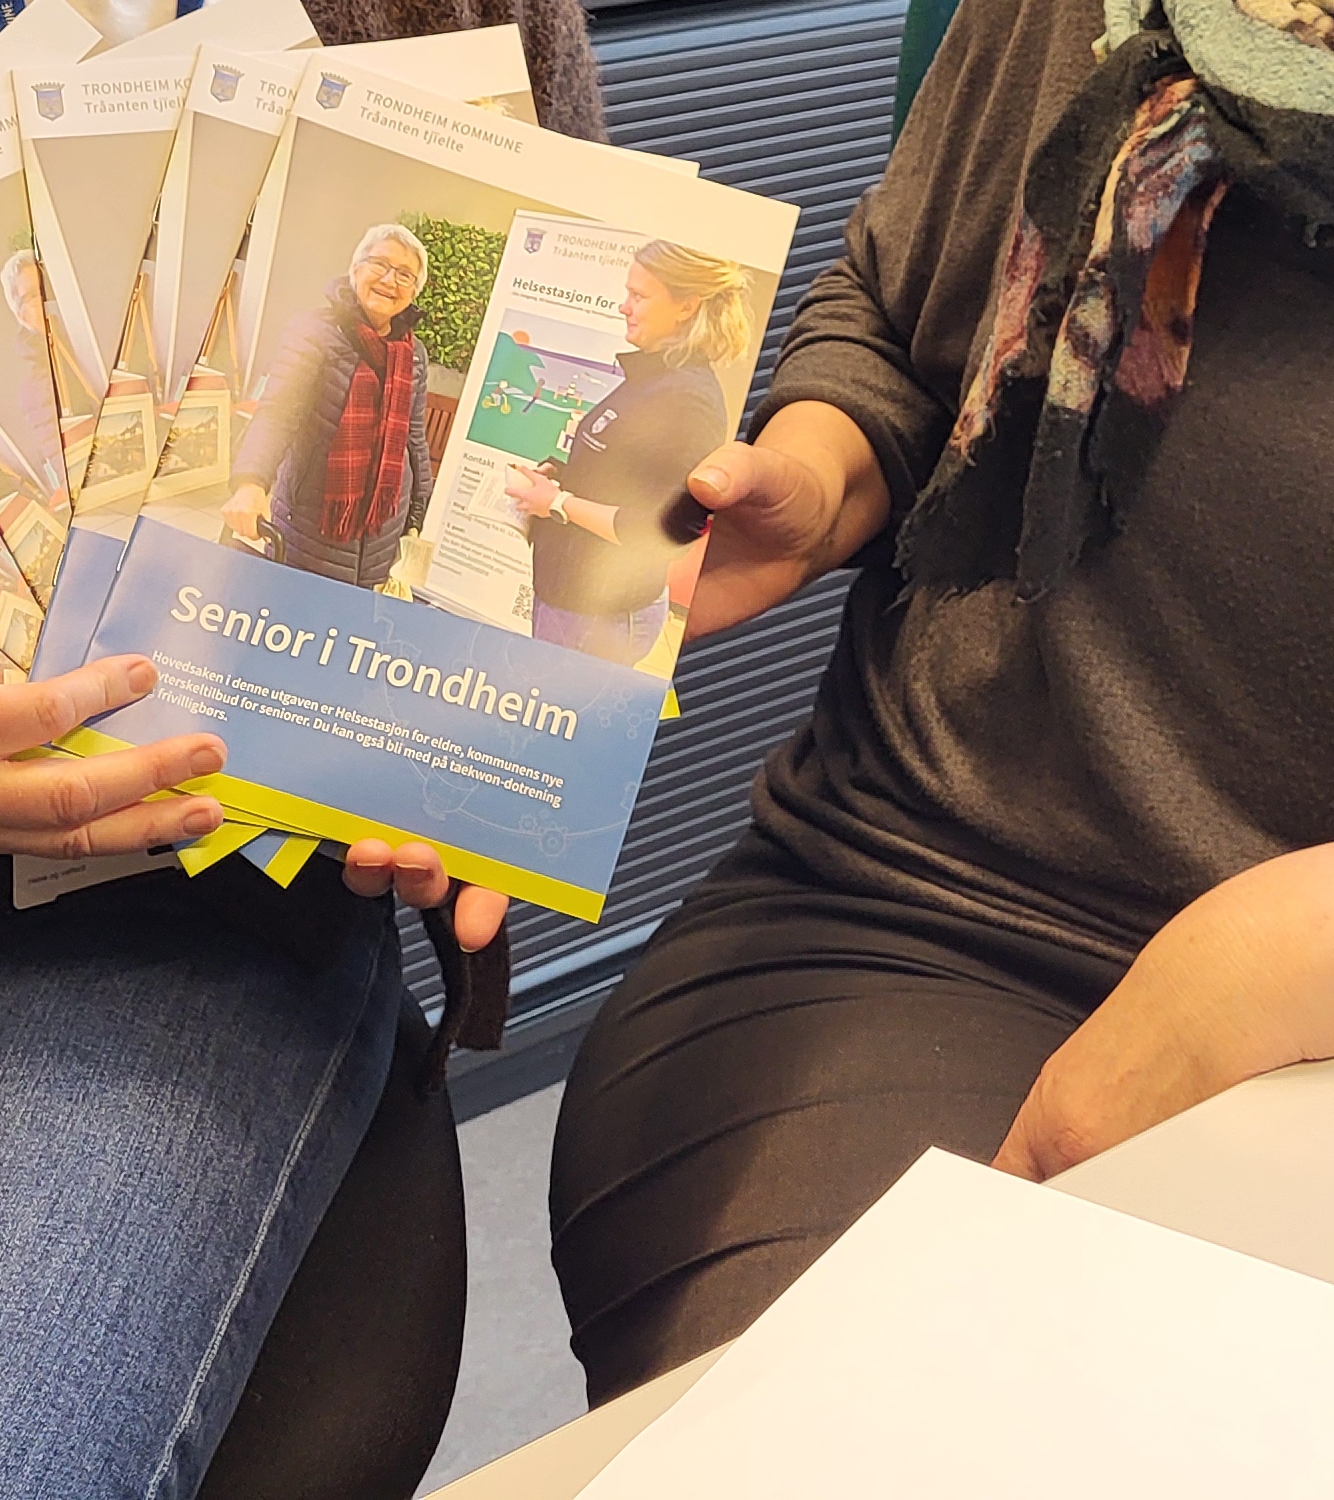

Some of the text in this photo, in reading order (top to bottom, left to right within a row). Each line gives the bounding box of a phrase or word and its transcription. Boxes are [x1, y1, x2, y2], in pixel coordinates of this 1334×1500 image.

[81, 78, 170, 96] TRONDHEIM
[83, 99, 149, 115] Tråanten
[359, 105, 420, 137] Tråanten
[366, 89, 524, 153] TRONDHEIM KOMMUNE
[557, 233, 618, 251] TRONDHEIM
[512, 277, 592, 304] Helsestasjon
[595, 295, 616, 310] for
[463, 452, 496, 469] Kontakt
[170, 585, 579, 742] Senior i Trondheim
[153, 650, 224, 684] Hovedsaken
[231, 677, 269, 697] denne
[271, 690, 319, 712] utgaven
[320, 705, 334, 715] er
[334, 706, 410, 739] Helsestasjon
[411, 728, 430, 744] for
[431, 737, 465, 759] eldre,
[467, 745, 540, 780] kommunens
[541, 774, 564, 790] nye
[158, 671, 238, 706] vterskeltilbud
[240, 696, 258, 712] for
[259, 703, 310, 728] seniorer.
[313, 717, 331, 732] Du
[332, 722, 354, 740] kan
[356, 732, 385, 749] også
[386, 739, 402, 755] bli
[403, 747, 431, 763] med
[431, 755, 448, 769] på
[450, 759, 562, 809] taekwon-dotrening
